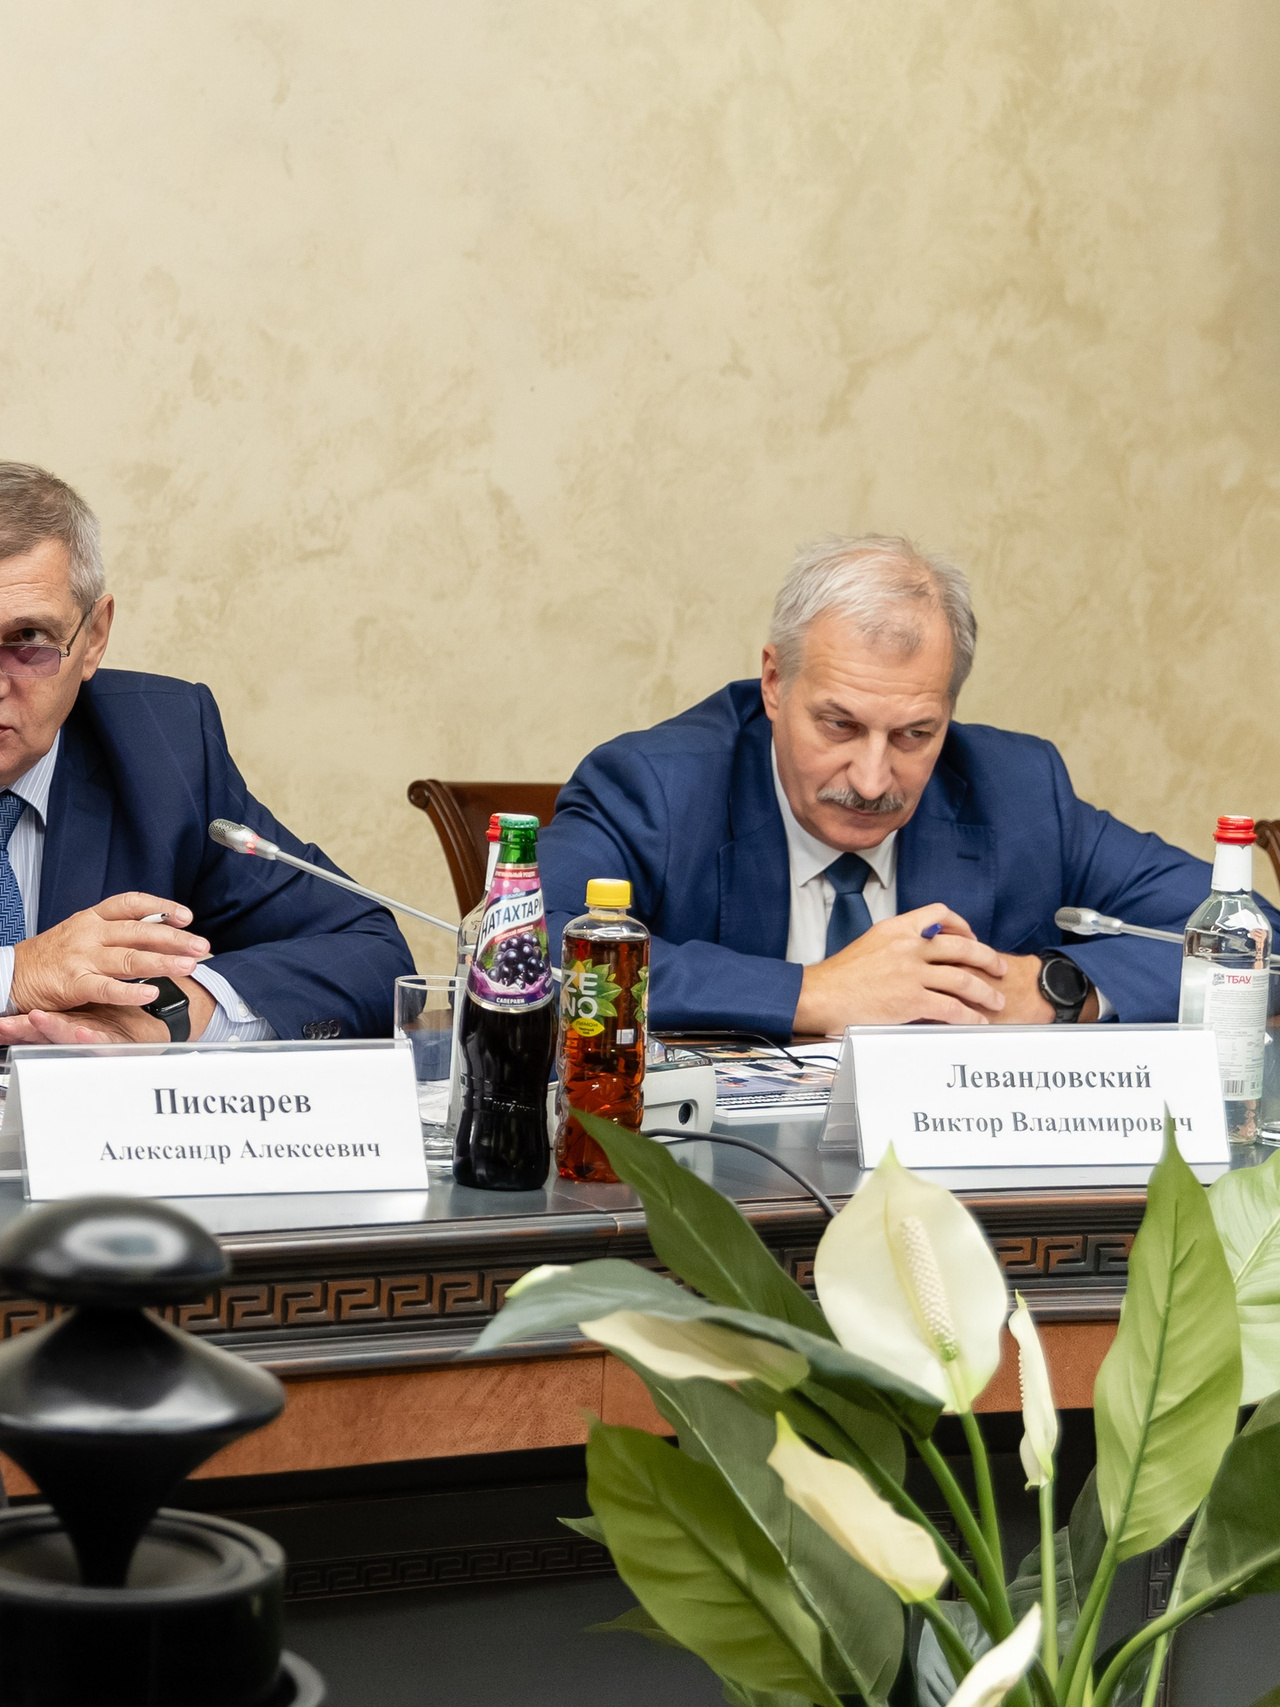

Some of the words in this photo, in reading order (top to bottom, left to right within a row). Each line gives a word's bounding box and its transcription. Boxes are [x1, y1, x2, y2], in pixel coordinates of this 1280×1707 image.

[1226, 975, 1251, 984] ТБАУ
[946, 1064, 1151, 1091] Левандовский
[152, 1087, 312, 1121] Пискарев
[912, 1111, 1003, 1138] Виктор
[99, 1141, 231, 1164] Александр
[240, 1138, 381, 1159] Алексеевич
